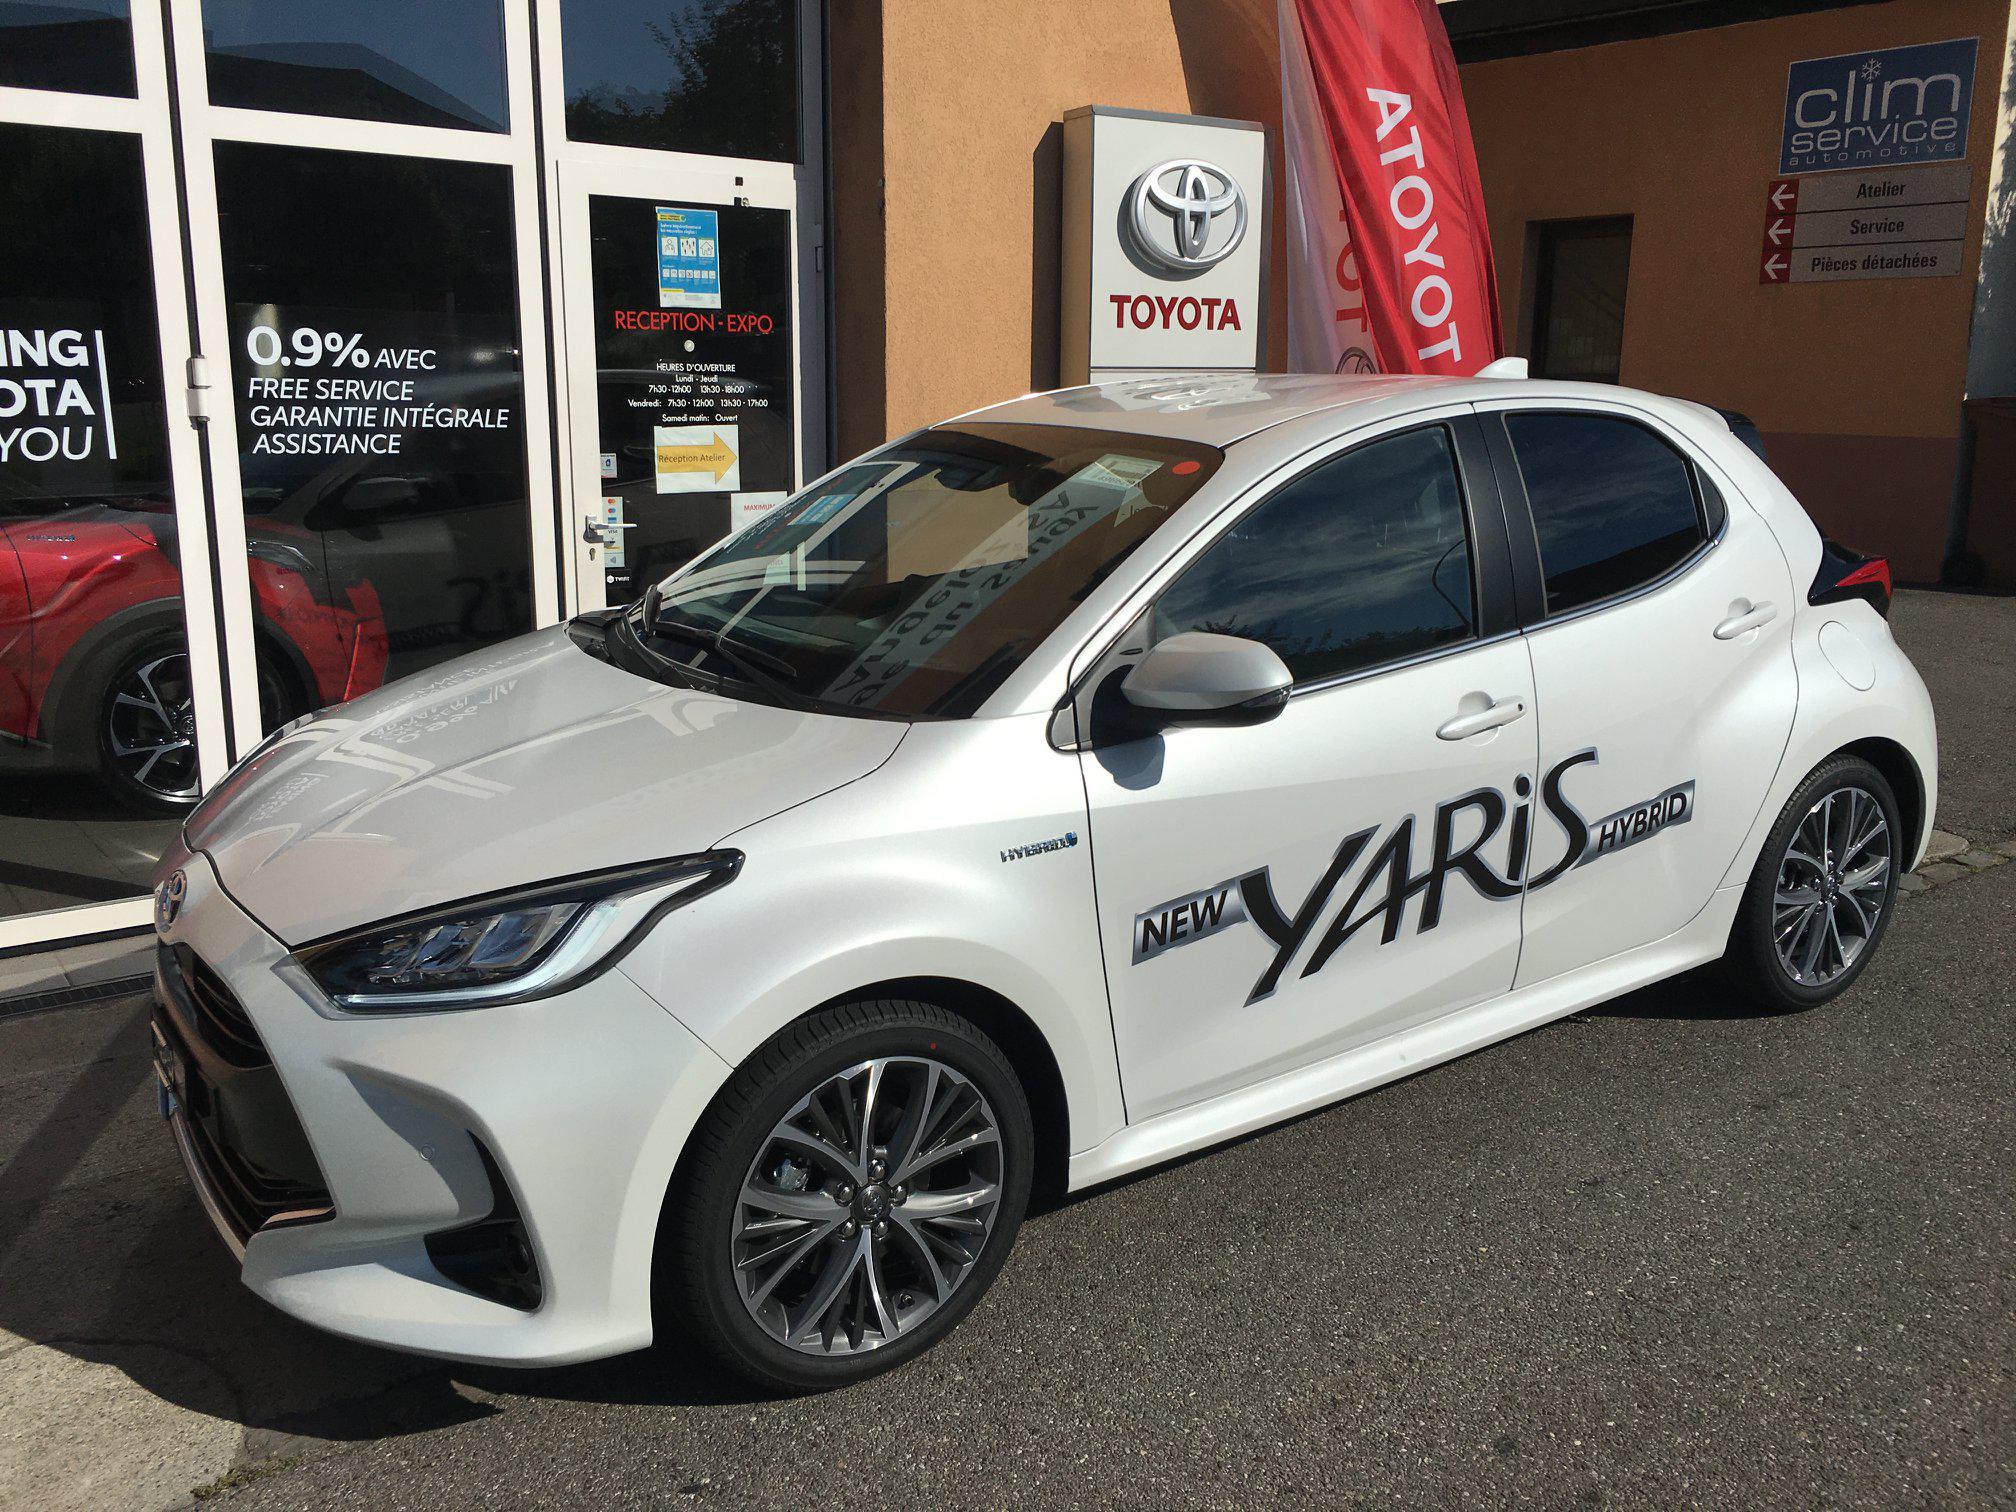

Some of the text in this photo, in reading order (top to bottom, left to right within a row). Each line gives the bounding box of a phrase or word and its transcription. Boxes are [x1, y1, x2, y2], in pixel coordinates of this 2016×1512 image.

[1794, 66, 1961, 128] clim
[1790, 115, 1958, 153] service
[1789, 142, 1956, 167] automotive
[1856, 181, 1907, 199] Atelier
[1849, 218, 1905, 235] Service
[1811, 252, 1938, 273] Pièces détachées
[615, 310, 715, 332] RECEPTION
[727, 314, 774, 333] EXPO
[1110, 294, 1241, 331] TOYOTA
[246, 325, 437, 371] 0.9% AVEC
[656, 362, 736, 374] HEURES D'OUVERTURE
[675, 373, 694, 383] Lundi
[700, 373, 719, 383] Jeudi
[249, 377, 415, 401] FREE SERVICE
[627, 398, 662, 408] Vendredi:
[667, 399, 687, 408] 7h30
[692, 399, 715, 408] 12h00
[720, 399, 742, 408] 13h30
[747, 399, 769, 408] 17h00
[250, 403, 510, 429] GARANTIE INTÉGRALE
[661, 413, 738, 423] Samedi matin: Ouvert
[0, 426, 93, 463] YOU
[252, 433, 402, 455] ASSISTANCE
[658, 452, 726, 464] Réception Atelier
[1597, 792, 1688, 852] HYBRID
[1141, 888, 1229, 954] NEW
